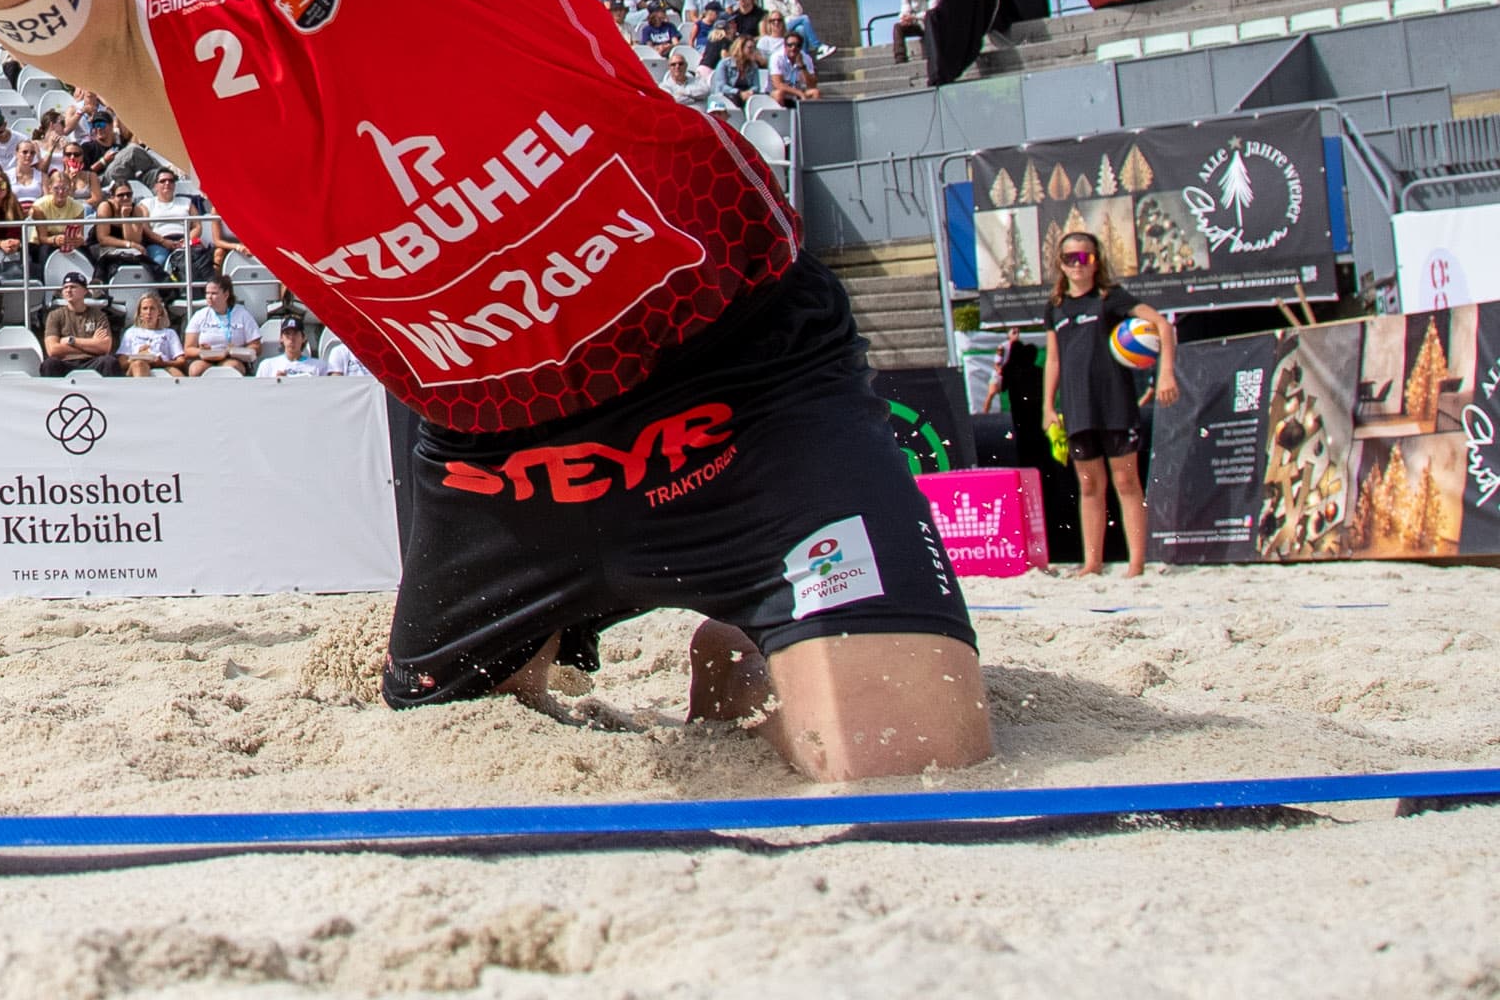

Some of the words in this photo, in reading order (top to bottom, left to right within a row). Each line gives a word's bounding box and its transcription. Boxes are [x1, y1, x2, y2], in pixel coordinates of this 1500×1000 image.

[4, 15, 67, 44] HYP
[194, 29, 260, 99] 2
[2, 513, 163, 545] Kitzbühel
[918, 520, 951, 595] KIPSTA
[949, 541, 1017, 561] onehit
[12, 569, 41, 581] THE
[44, 568, 70, 580] SPA
[74, 567, 158, 579] MOMENTUM
[801, 567, 866, 598] SPORTPOOL
[818, 581, 848, 598] WIEN
